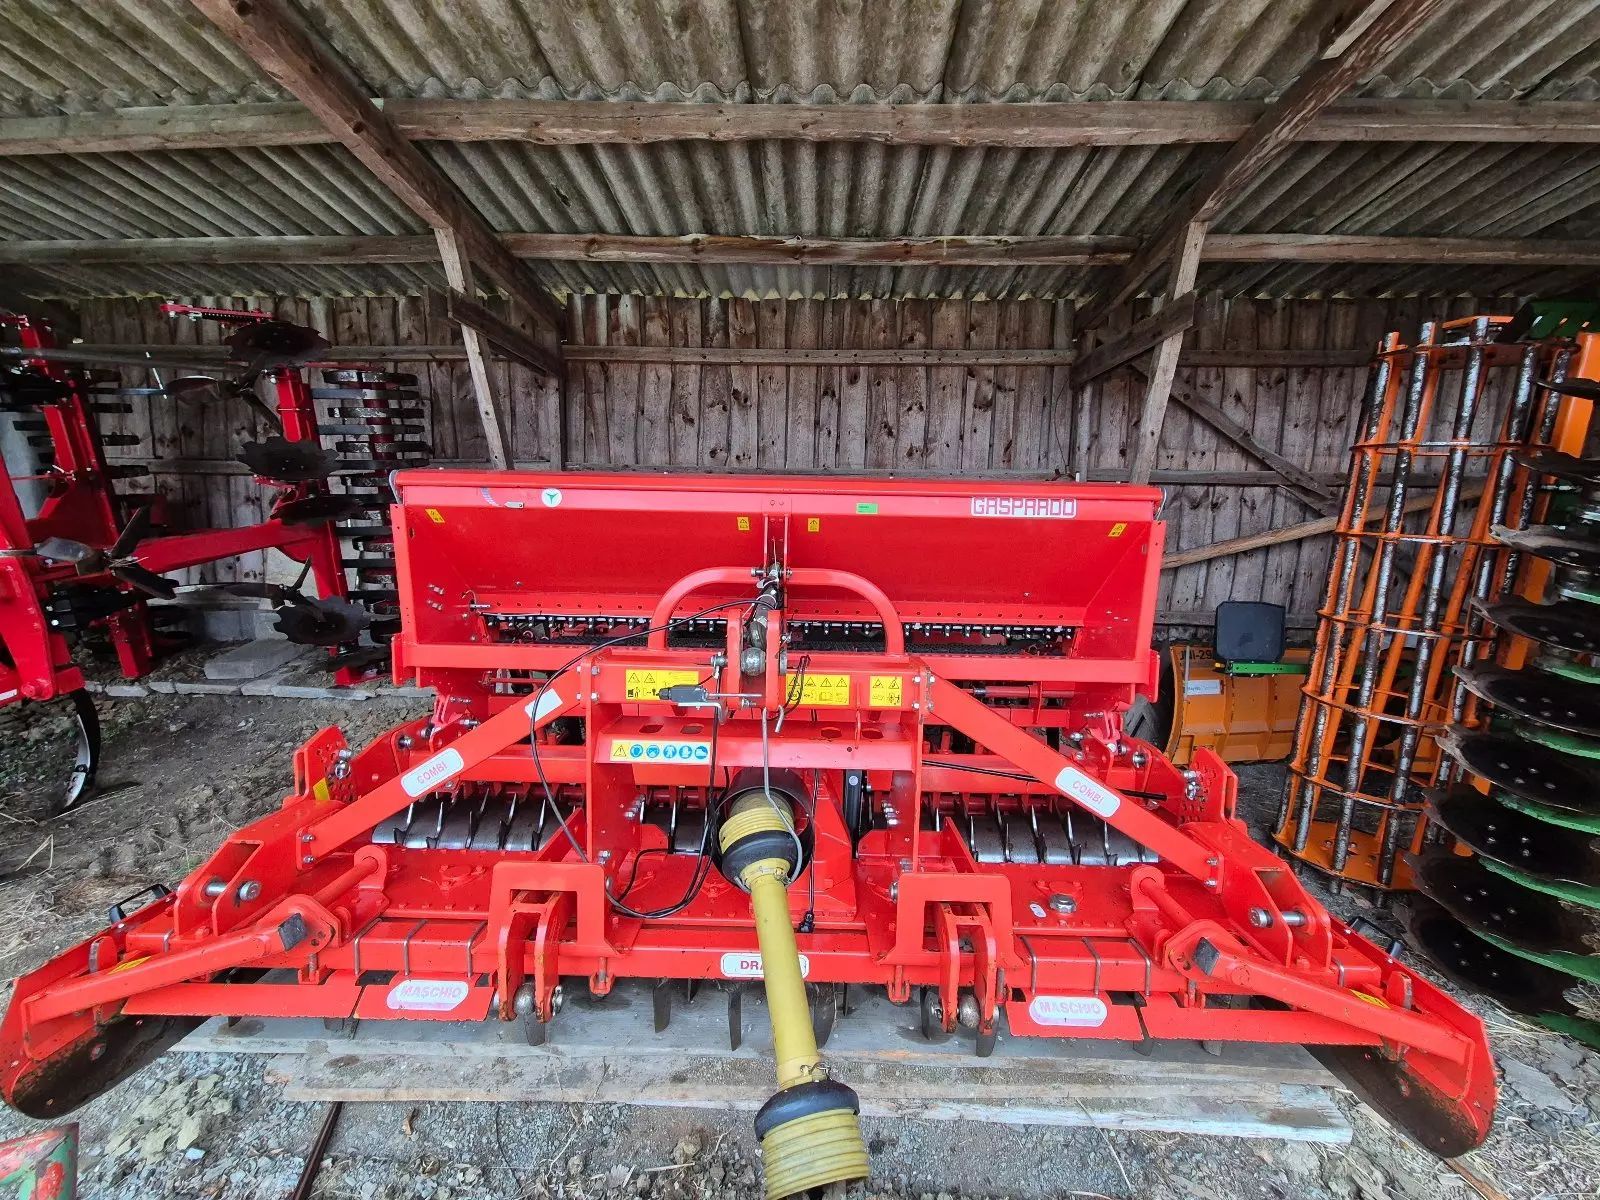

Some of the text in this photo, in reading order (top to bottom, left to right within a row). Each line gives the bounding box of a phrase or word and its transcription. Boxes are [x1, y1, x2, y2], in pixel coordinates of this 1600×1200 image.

[417, 760, 448, 784] COMBI
[1072, 780, 1104, 805] COMBI
[399, 985, 462, 998] MASCHIO
[1039, 1001, 1101, 1015] MASCHIO
